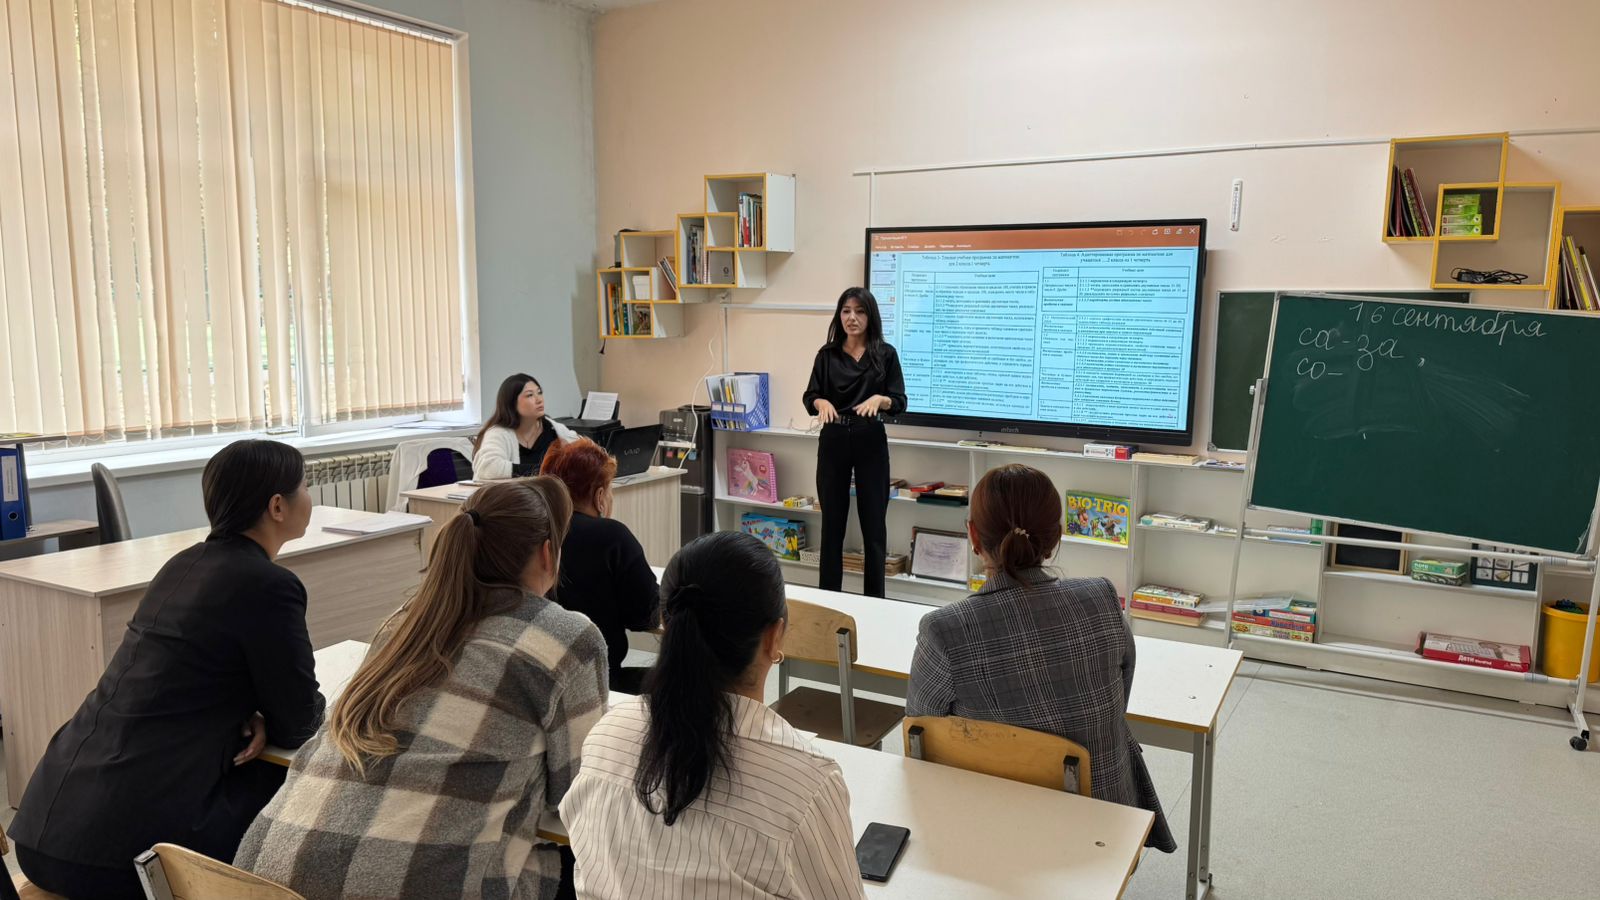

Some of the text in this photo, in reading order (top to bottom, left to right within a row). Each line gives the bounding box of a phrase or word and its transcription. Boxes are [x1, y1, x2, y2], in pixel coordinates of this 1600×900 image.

[1350, 302, 1548, 345] 16 сентября
[1067, 495, 1128, 516] BIO-TRIO
